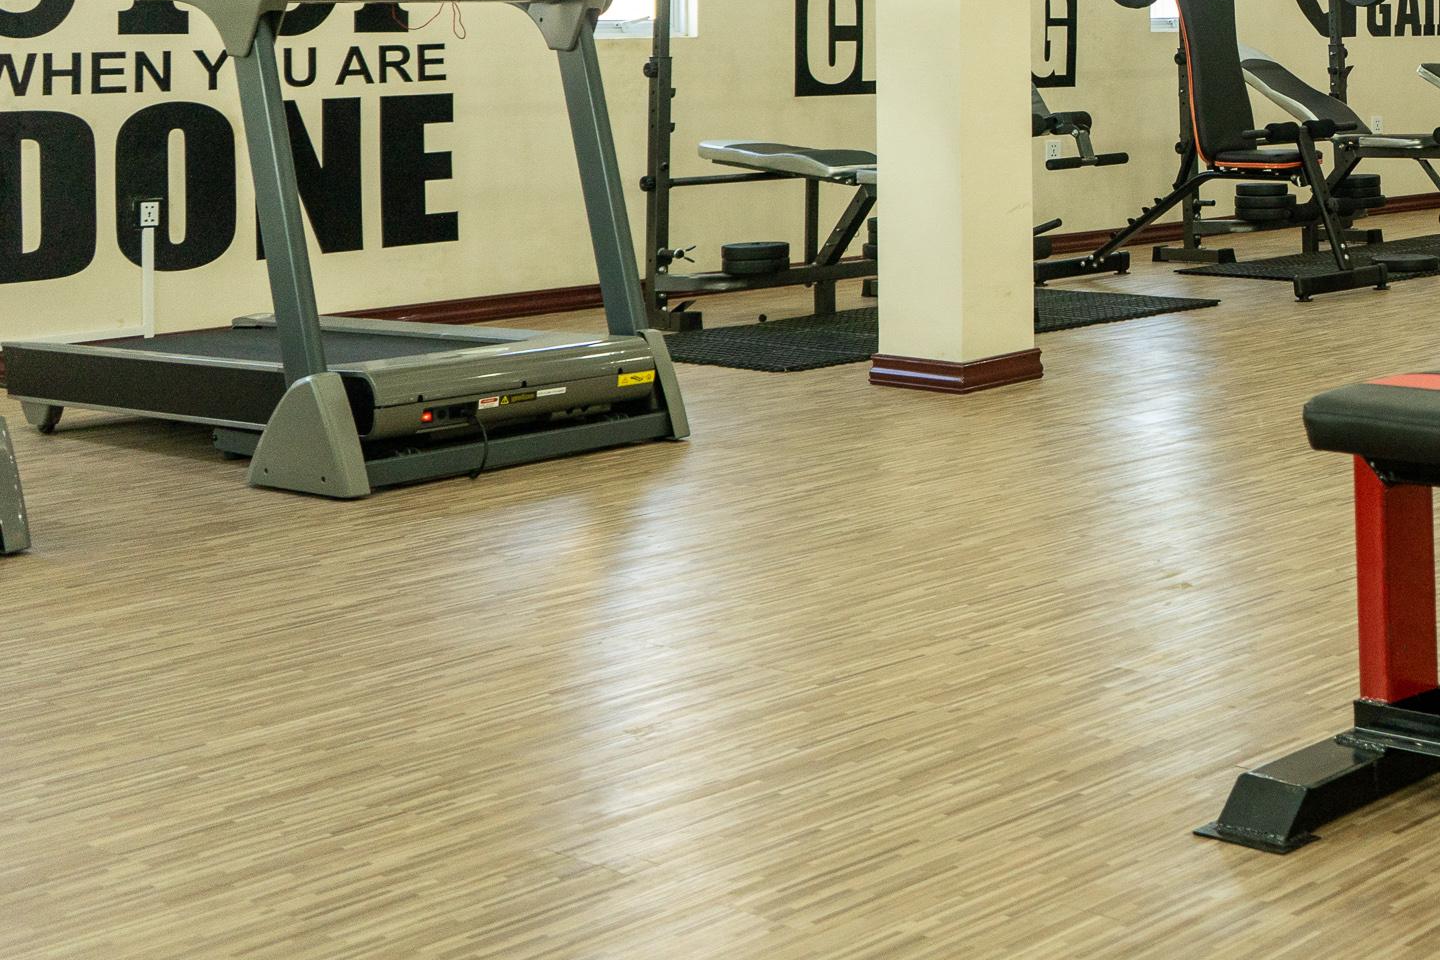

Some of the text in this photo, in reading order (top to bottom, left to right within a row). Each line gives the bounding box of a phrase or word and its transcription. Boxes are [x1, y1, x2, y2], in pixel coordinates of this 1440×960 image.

[0, 43, 447, 97] WHEN YU ARE
[0, 93, 459, 285] DONE
